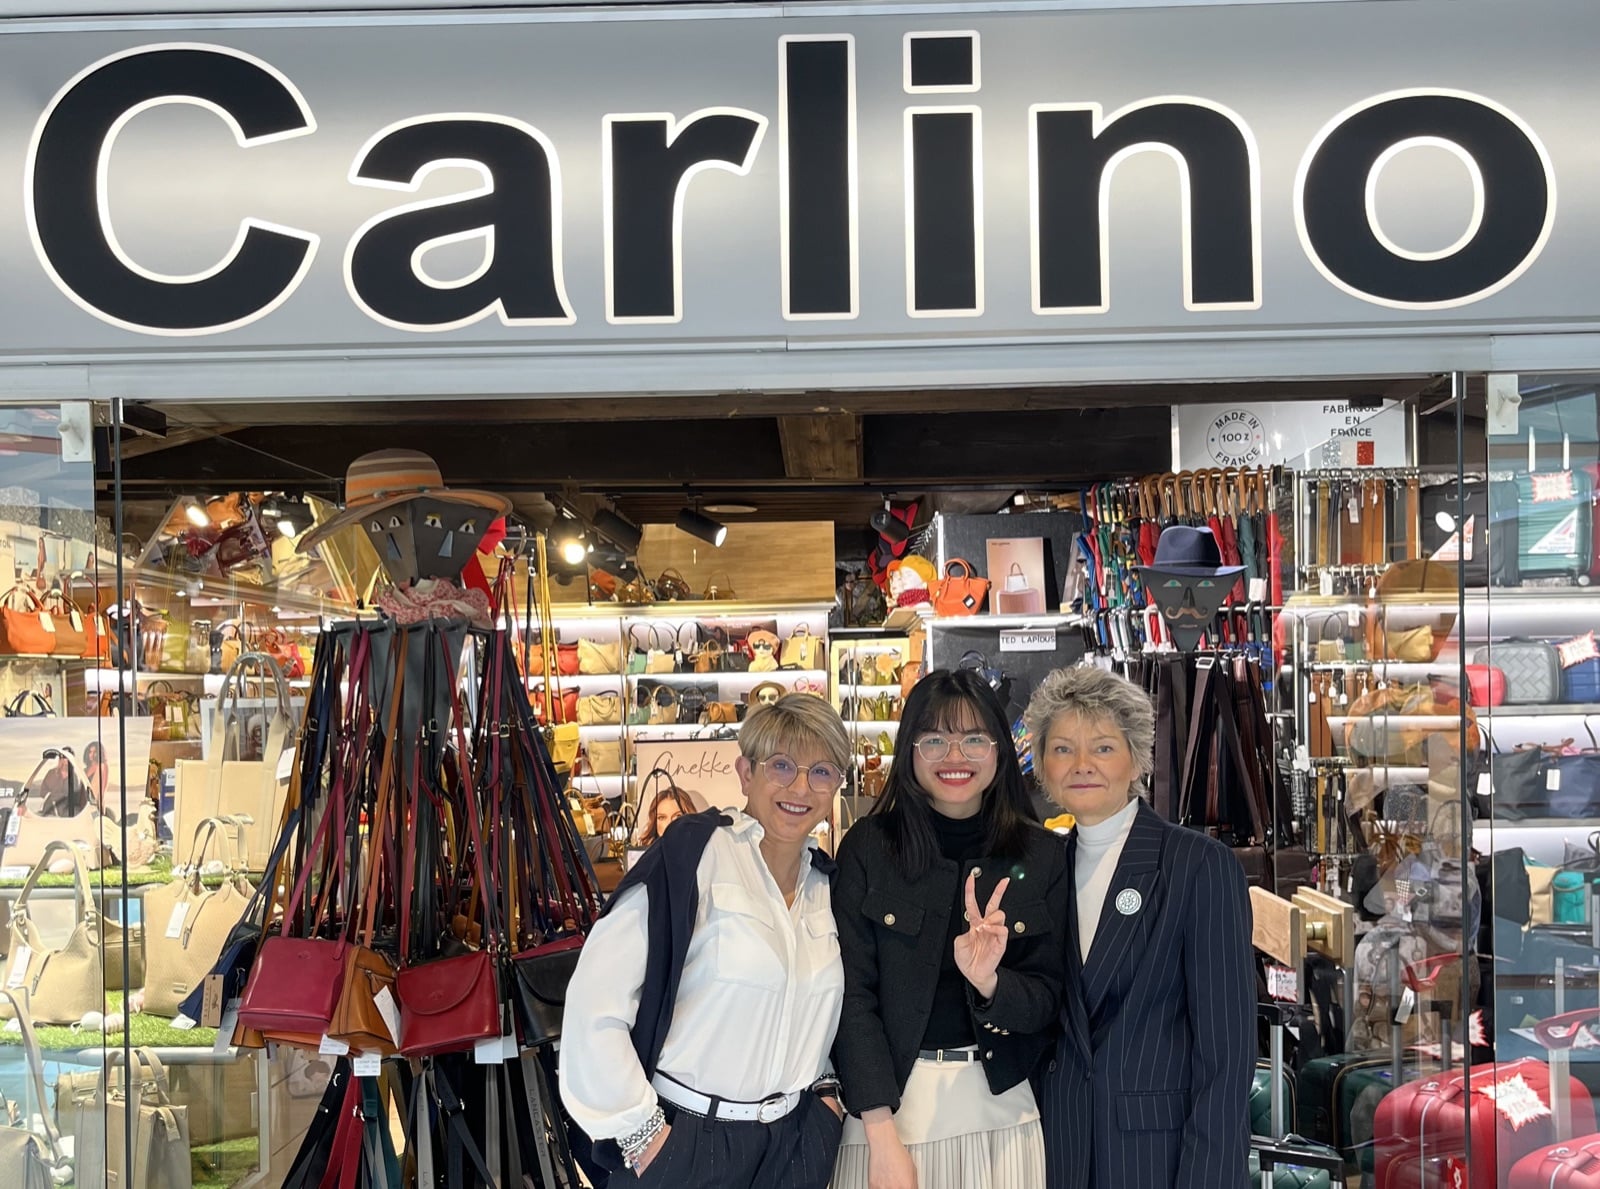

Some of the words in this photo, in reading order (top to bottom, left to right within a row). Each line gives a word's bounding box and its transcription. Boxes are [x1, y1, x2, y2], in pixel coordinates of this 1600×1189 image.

[24, 30, 1557, 336] Carlino
[1215, 411, 1246, 429] MADE
[1248, 417, 1259, 429] IN
[1345, 416, 1360, 425] EN
[1331, 428, 1372, 437] FRANCE
[1215, 447, 1259, 466] FRANCE
[1001, 636, 1016, 644] TED
[528, 1088, 546, 1158] LANCASTER
